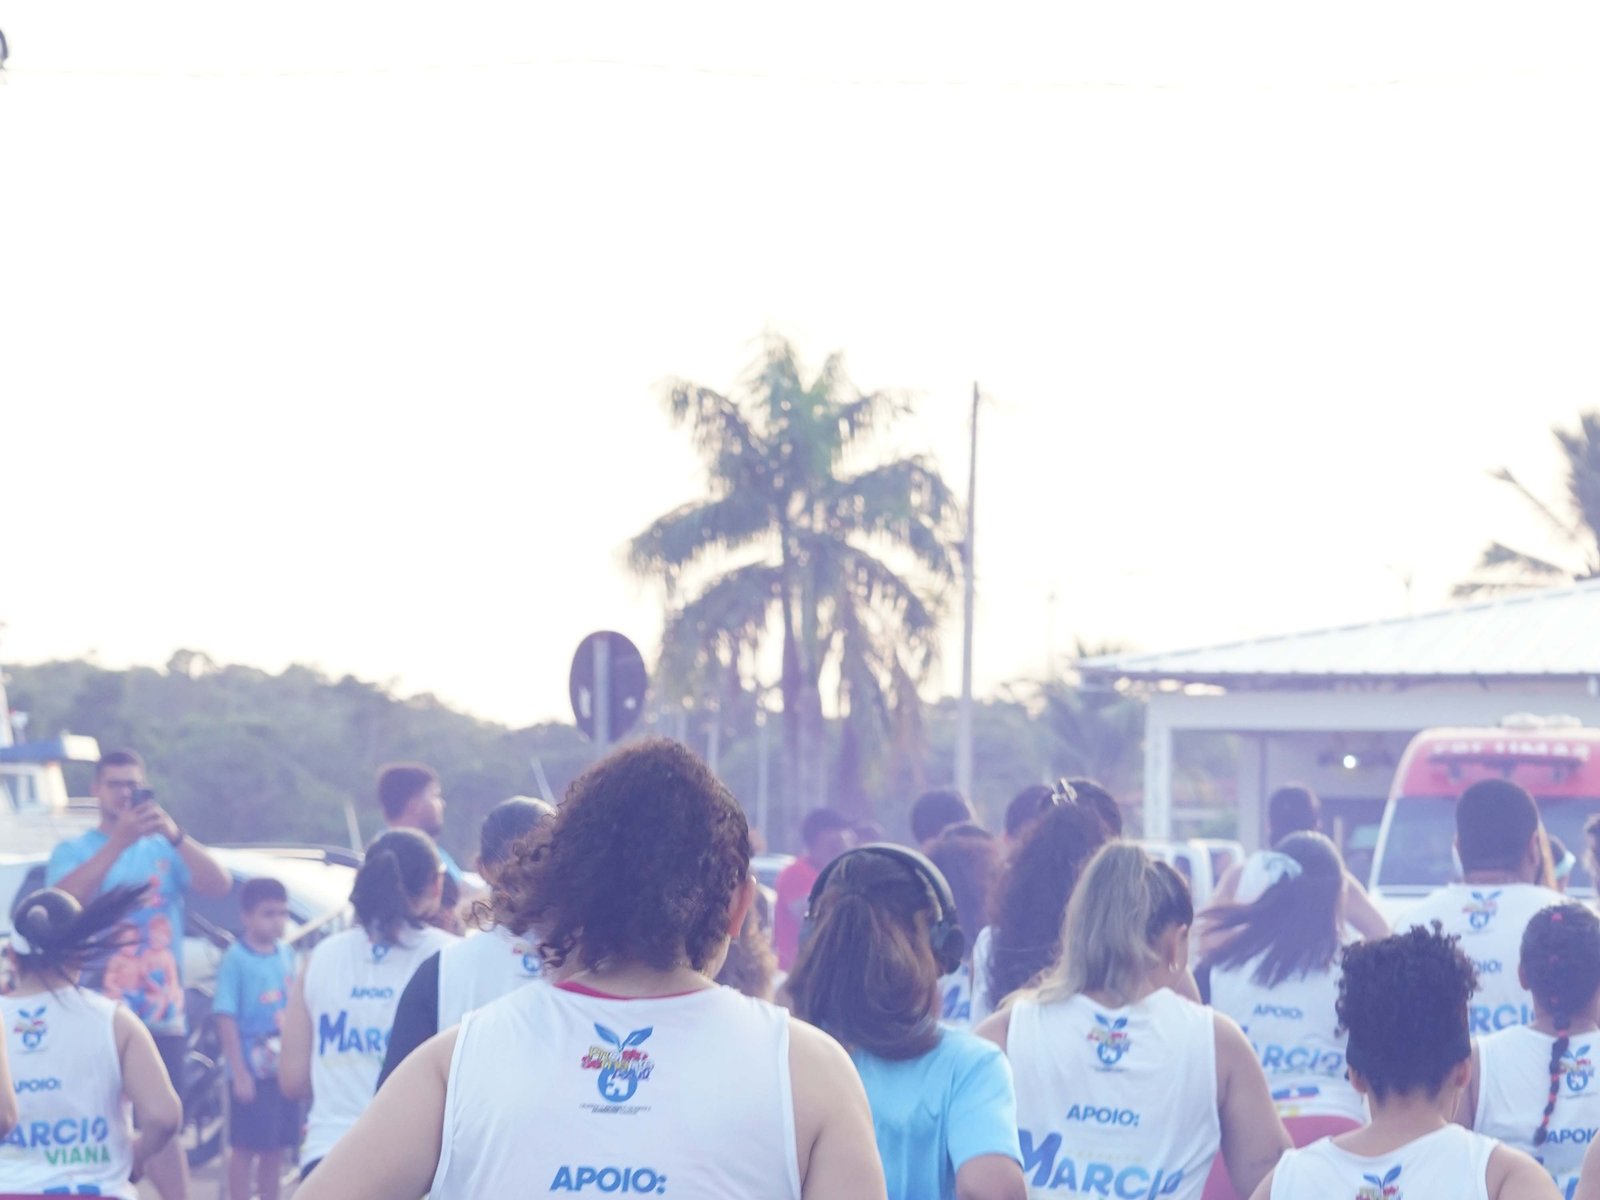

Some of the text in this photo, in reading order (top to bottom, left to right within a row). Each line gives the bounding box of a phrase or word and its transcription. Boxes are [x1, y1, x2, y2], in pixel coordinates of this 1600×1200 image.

[319, 1009, 391, 1056] MAR
[1253, 1043, 1342, 1072] RCIO
[1066, 1104, 1140, 1127] APOIO:
[2, 1116, 109, 1148] ARCIO
[550, 1166, 667, 1194] APOIO:
